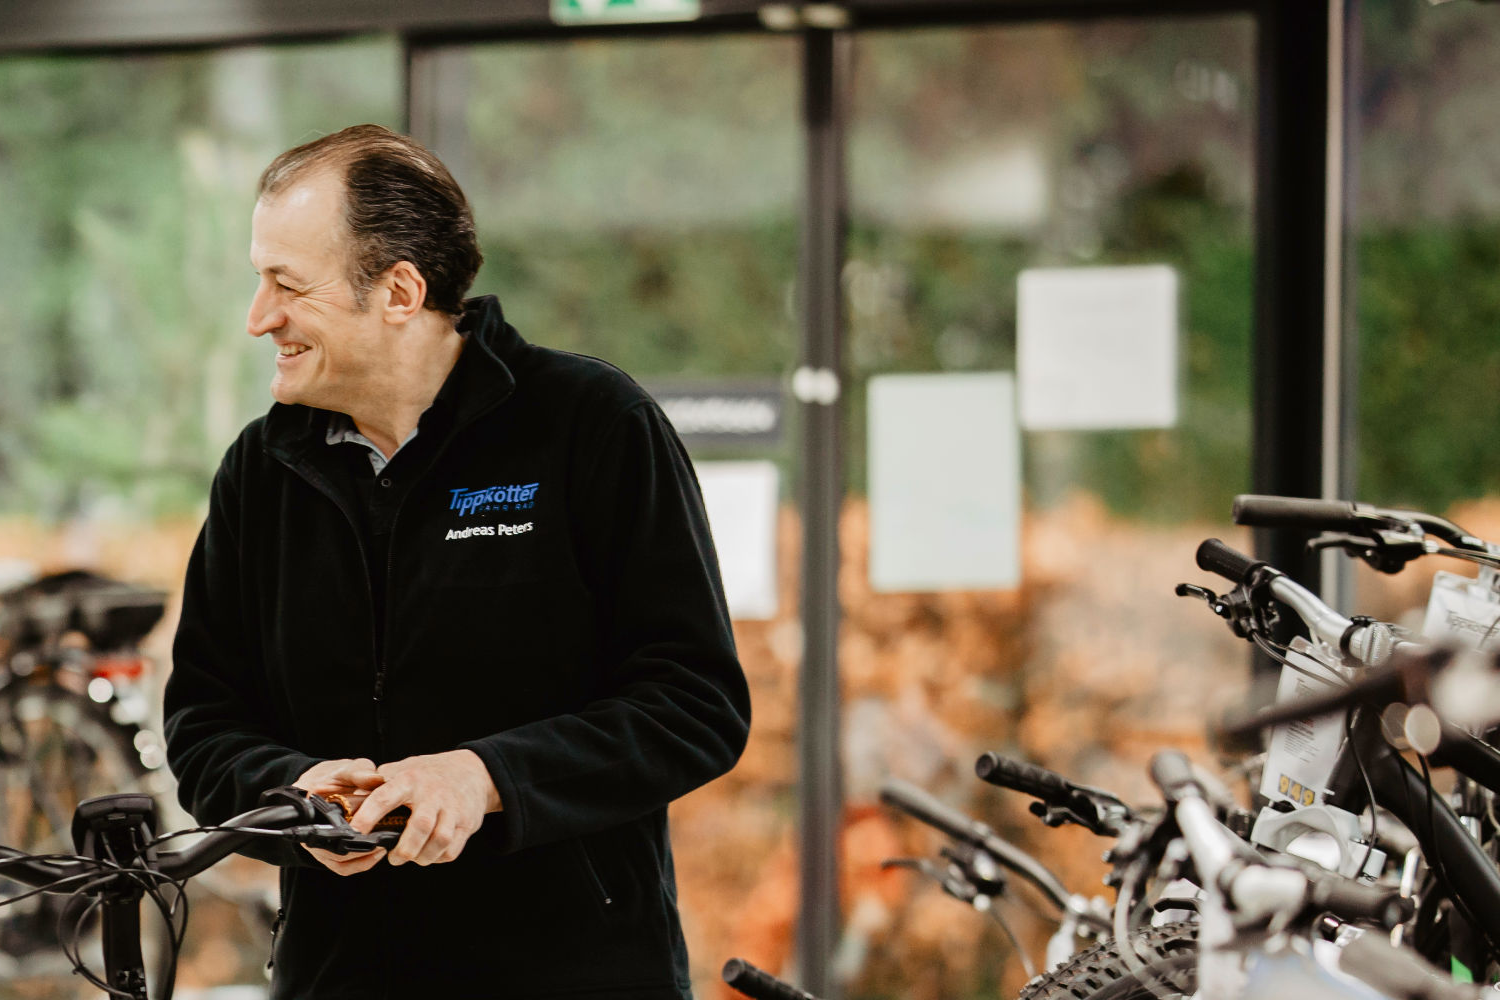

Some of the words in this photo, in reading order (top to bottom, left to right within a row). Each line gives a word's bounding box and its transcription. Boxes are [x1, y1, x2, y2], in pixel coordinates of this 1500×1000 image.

[449, 482, 539, 517] Tippkötter
[445, 526, 495, 541] Andreas
[498, 521, 534, 536] Peters
